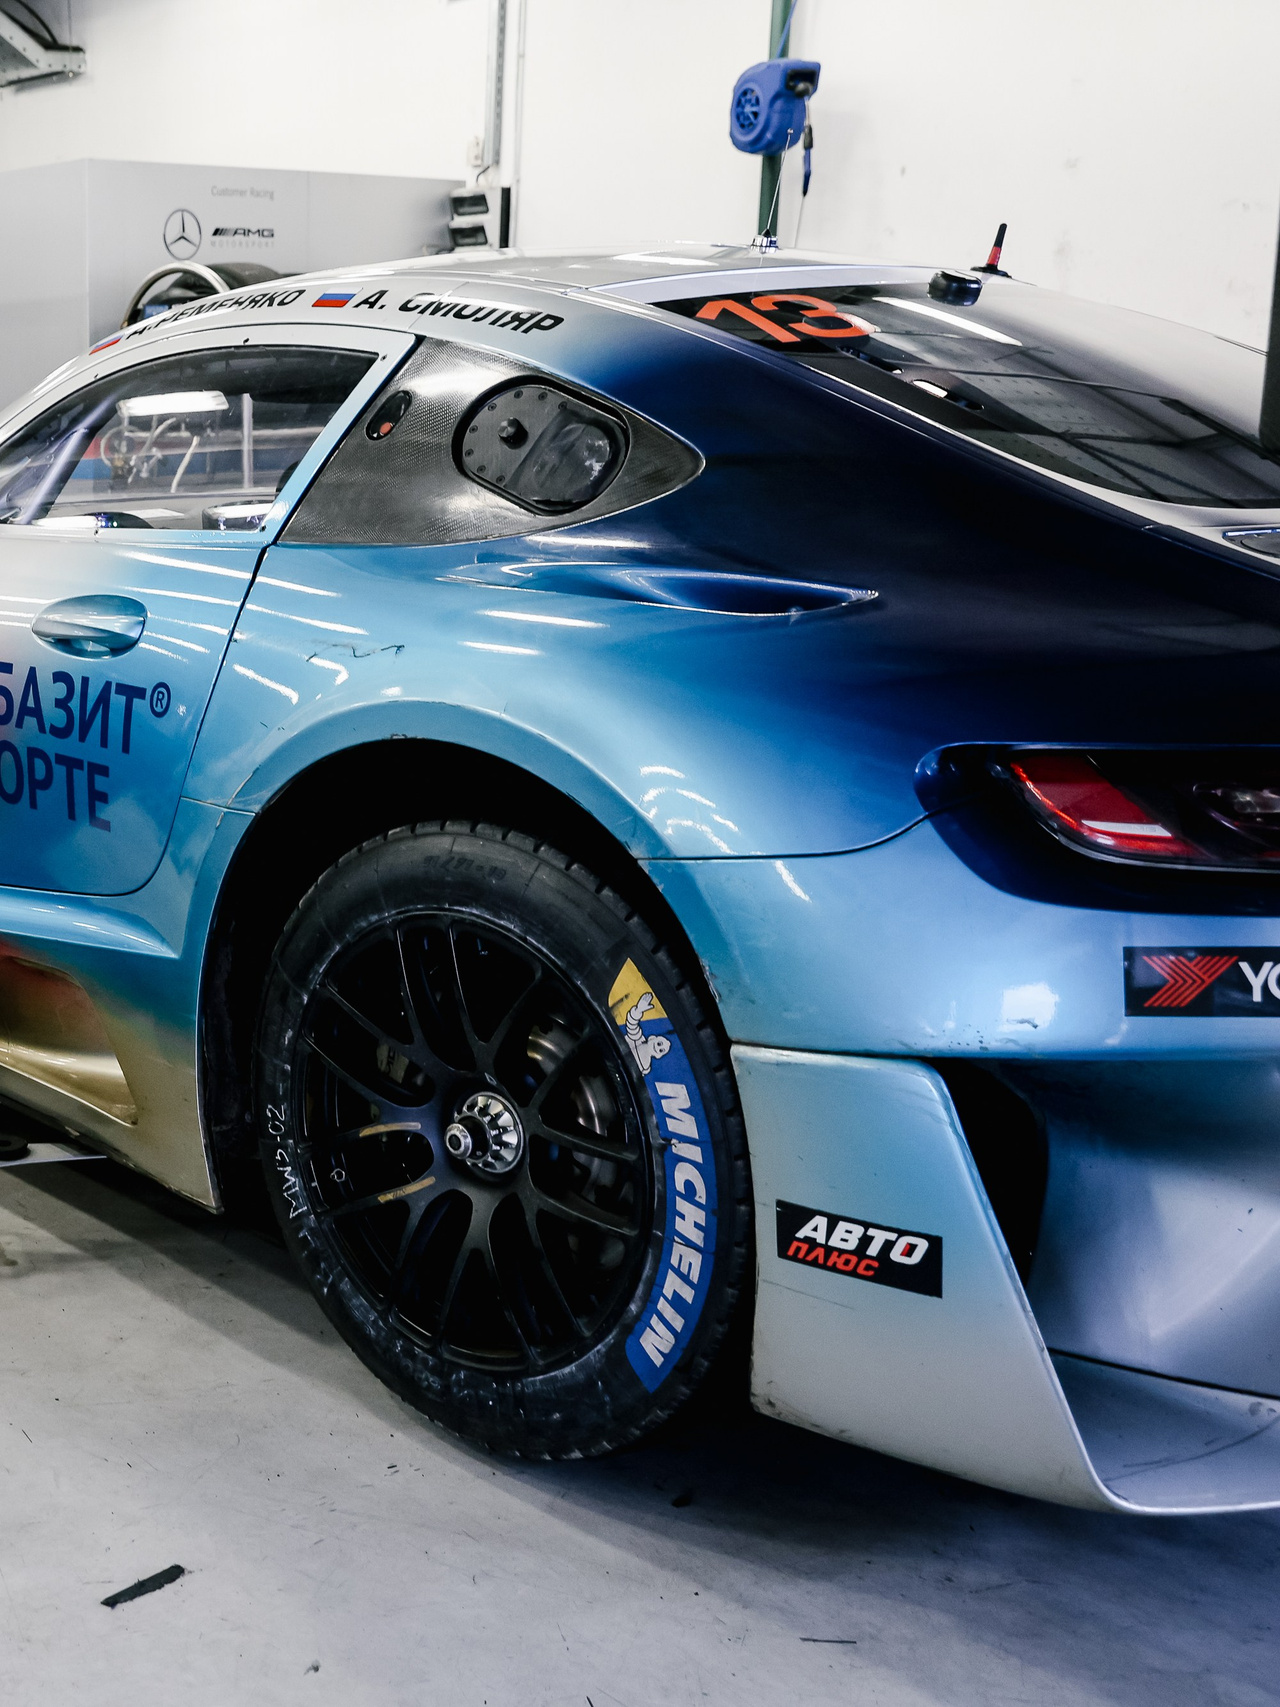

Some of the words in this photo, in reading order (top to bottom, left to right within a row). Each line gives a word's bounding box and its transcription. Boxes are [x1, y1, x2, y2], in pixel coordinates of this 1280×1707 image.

[249, 187, 275, 201] Racing
[233, 227, 275, 238] AMG
[353, 289, 389, 309] А.
[398, 292, 565, 335] СМОЛЯР
[695, 293, 881, 344] 13
[639, 1081, 706, 1368] MICHELIN
[795, 1214, 929, 1266] АВТО
[787, 1240, 880, 1277] ПЛЮС
